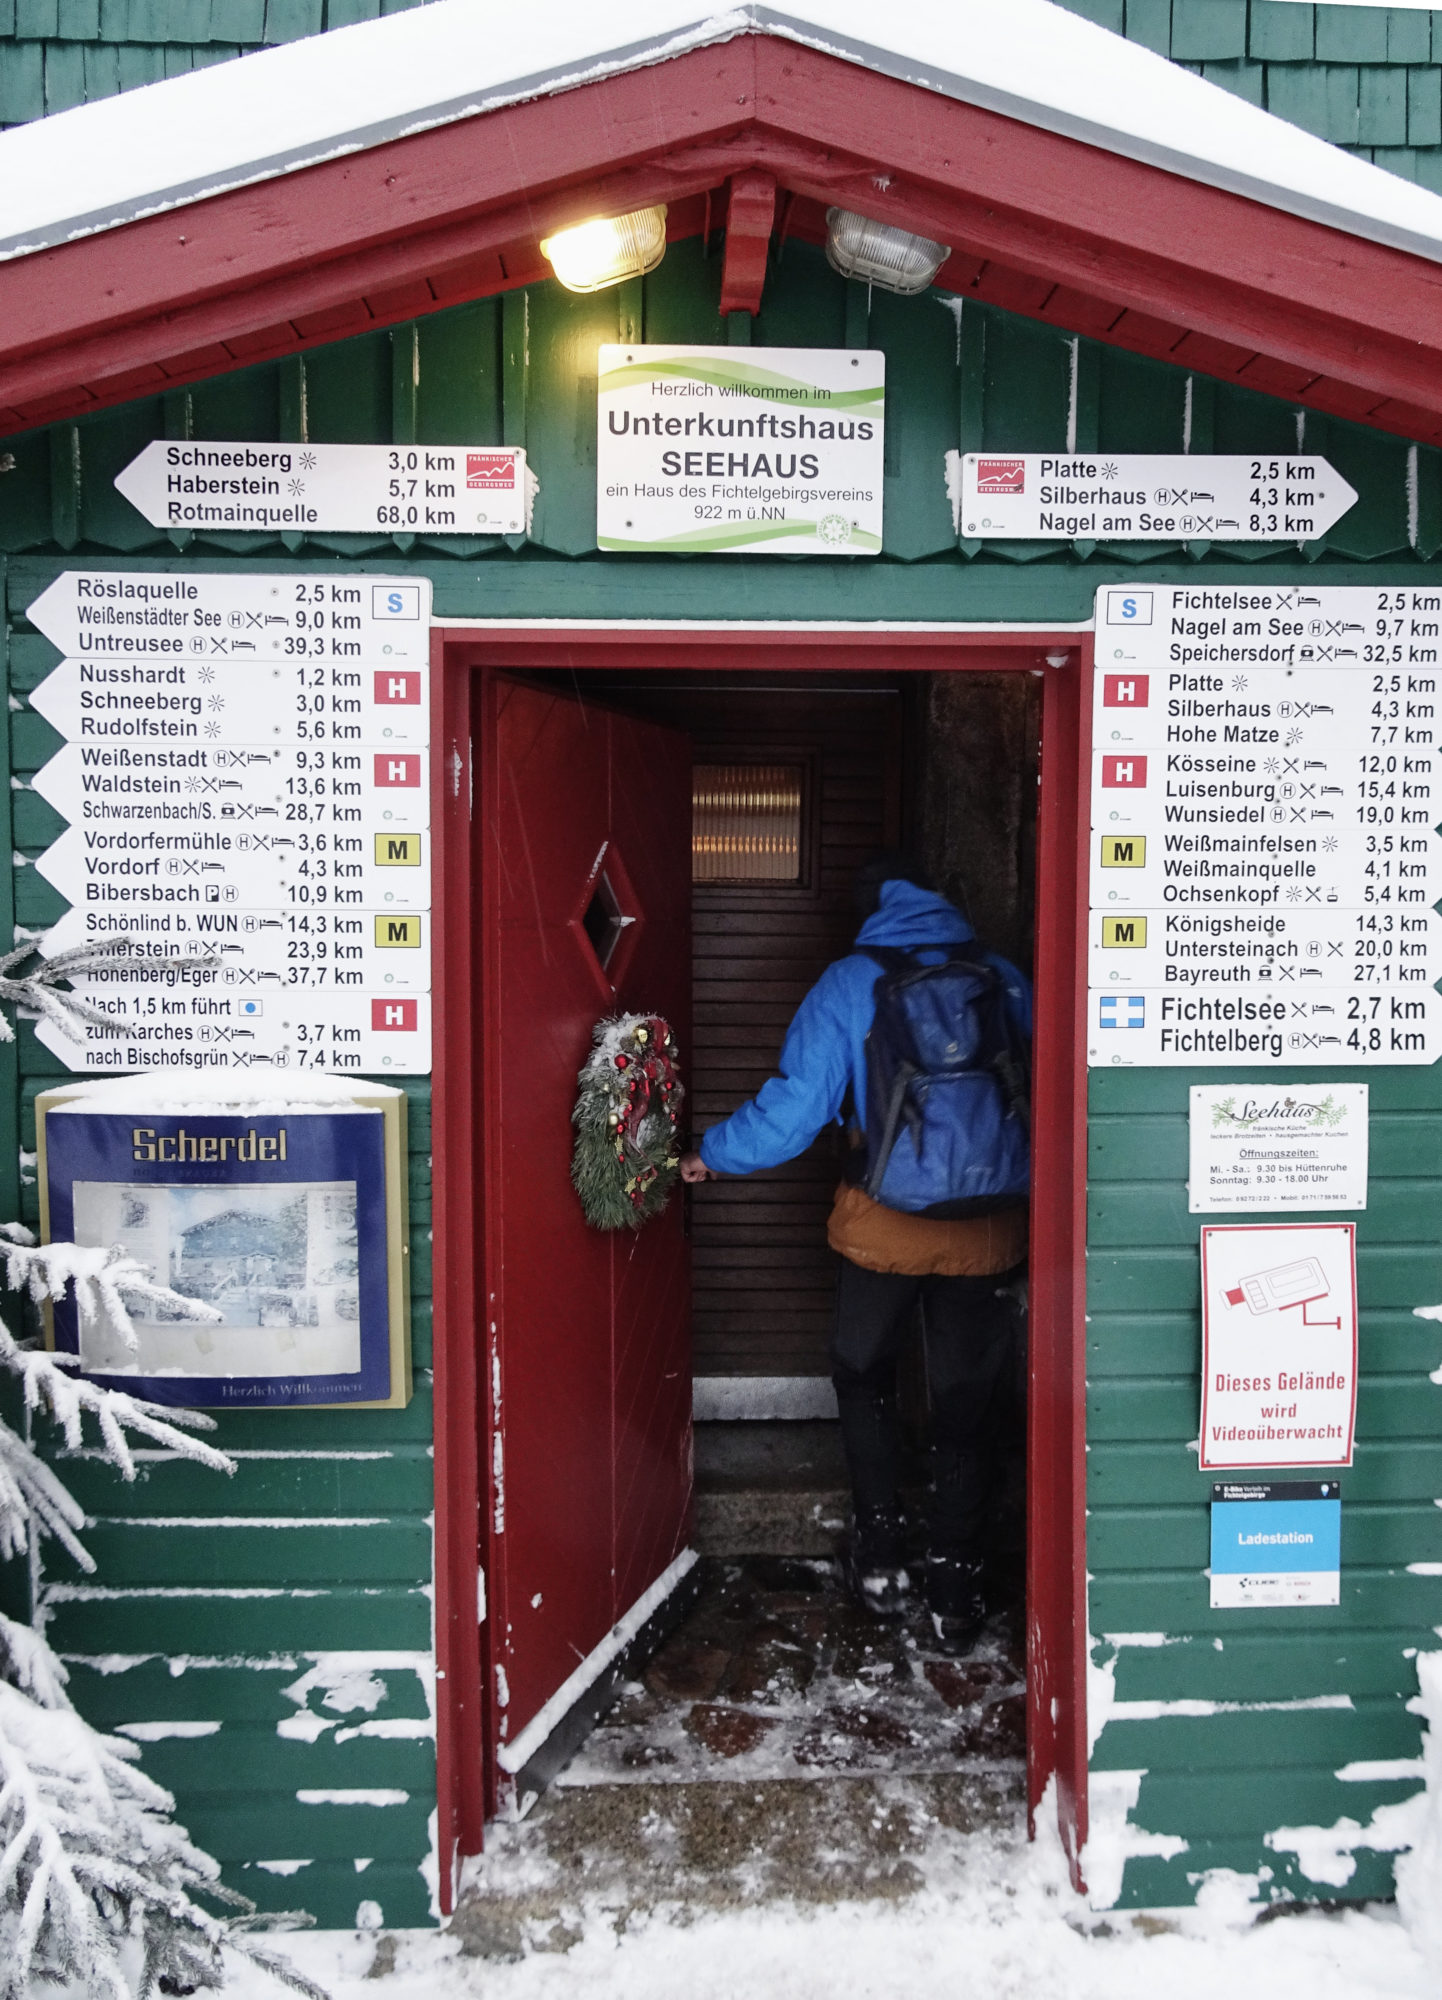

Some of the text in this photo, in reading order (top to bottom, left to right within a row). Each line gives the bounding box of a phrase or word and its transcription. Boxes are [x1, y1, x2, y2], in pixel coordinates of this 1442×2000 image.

[652, 382, 831, 400] Herzlich willkommen im
[609, 411, 873, 440] Unterkunftshaus
[167, 447, 454, 473] Schneeberg 3,0 km
[662, 451, 818, 479] SEEHAUS
[1041, 460, 1314, 482] Platte 2,5 km
[168, 475, 454, 500] Haberstein 5,7 km
[606, 484, 873, 503] ein Haus des Fichtelgebirgsvereins
[1040, 486, 1313, 508] Silberhaus 4,3 km
[168, 502, 454, 526] Rotmainquelle 68,0 km
[695, 506, 784, 520] 922 m ü.NN
[1040, 513, 1313, 535] Nagel am See 8,3 km
[78, 579, 360, 605] Röslaquelle 2,5 km
[1173, 592, 1440, 613] Fichtelsee 2,5 km
[78, 606, 360, 631] Weißenstädter See 9,0 km
[1172, 618, 1438, 639] Nagel am See 9,7 km
[80, 633, 360, 657] Untreusee 39,3 km
[1169, 644, 1436, 664] Speichersdorf 32,5 km
[81, 665, 360, 688] Nusshardt 1,2 km
[82, 717, 360, 741] Rudolfstein 5,6 km
[1168, 725, 1432, 746] Hohe Matze 7,7 km
[81, 749, 360, 771] Weißenstadt 9,3 km
[1168, 755, 1431, 775] Kösseine 12,0 km
[82, 775, 361, 797] Waldstein 13,6 km
[1167, 781, 1429, 802] Luisenburg 15,4 km
[83, 801, 361, 823] Schwarzenbach/S. 28,7 km
[1165, 806, 1428, 825] Wunsiedel 19,0 km
[84, 831, 362, 854] Vordorfermühle 3,6 km
[1165, 835, 1427, 855] Weißmainfelsen 3,5 km
[85, 857, 362, 879] Vordorf 4,3 km
[1164, 860, 1426, 881] Weißmainquelle 4,1 km
[87, 883, 362, 905] Bibersbach 10,9 km
[1164, 885, 1425, 906] Ochsenkopf 5,4 km
[87, 913, 362, 935] Schönlind b. WUN 14,3 km
[1166, 915, 1427, 936] Königsheide 14,3 km
[1166, 940, 1426, 959] Untersteinach 20,0 km
[288, 967, 327, 986] 37,7
[335, 968, 362, 984] km
[1166, 965, 1425, 985] Bayreuth 27,1 km
[1162, 997, 1425, 1023] Fichtelsee 2,7 km
[1162, 1028, 1424, 1057] Fichtelberg 4,8 km
[87, 1048, 360, 1069] nach Bischofsgrün 7,4 km
[1242, 1100, 1314, 1120] Seehaus
[133, 1129, 287, 1161] Scherdel
[1239, 1149, 1319, 1159] Öffnungszeiten:
[1279, 1164, 1292, 1172] bis
[1296, 1163, 1347, 1171] Hüttenruhe
[1210, 1176, 1251, 1185] Sonntag:
[223, 1385, 275, 1396] Herzlich
[1216, 1372, 1345, 1391] Dieses Gelände
[1261, 1404, 1297, 1418] wird
[1213, 1425, 1343, 1441] Videoüberwacht
[1238, 1532, 1313, 1545] Ladestation
